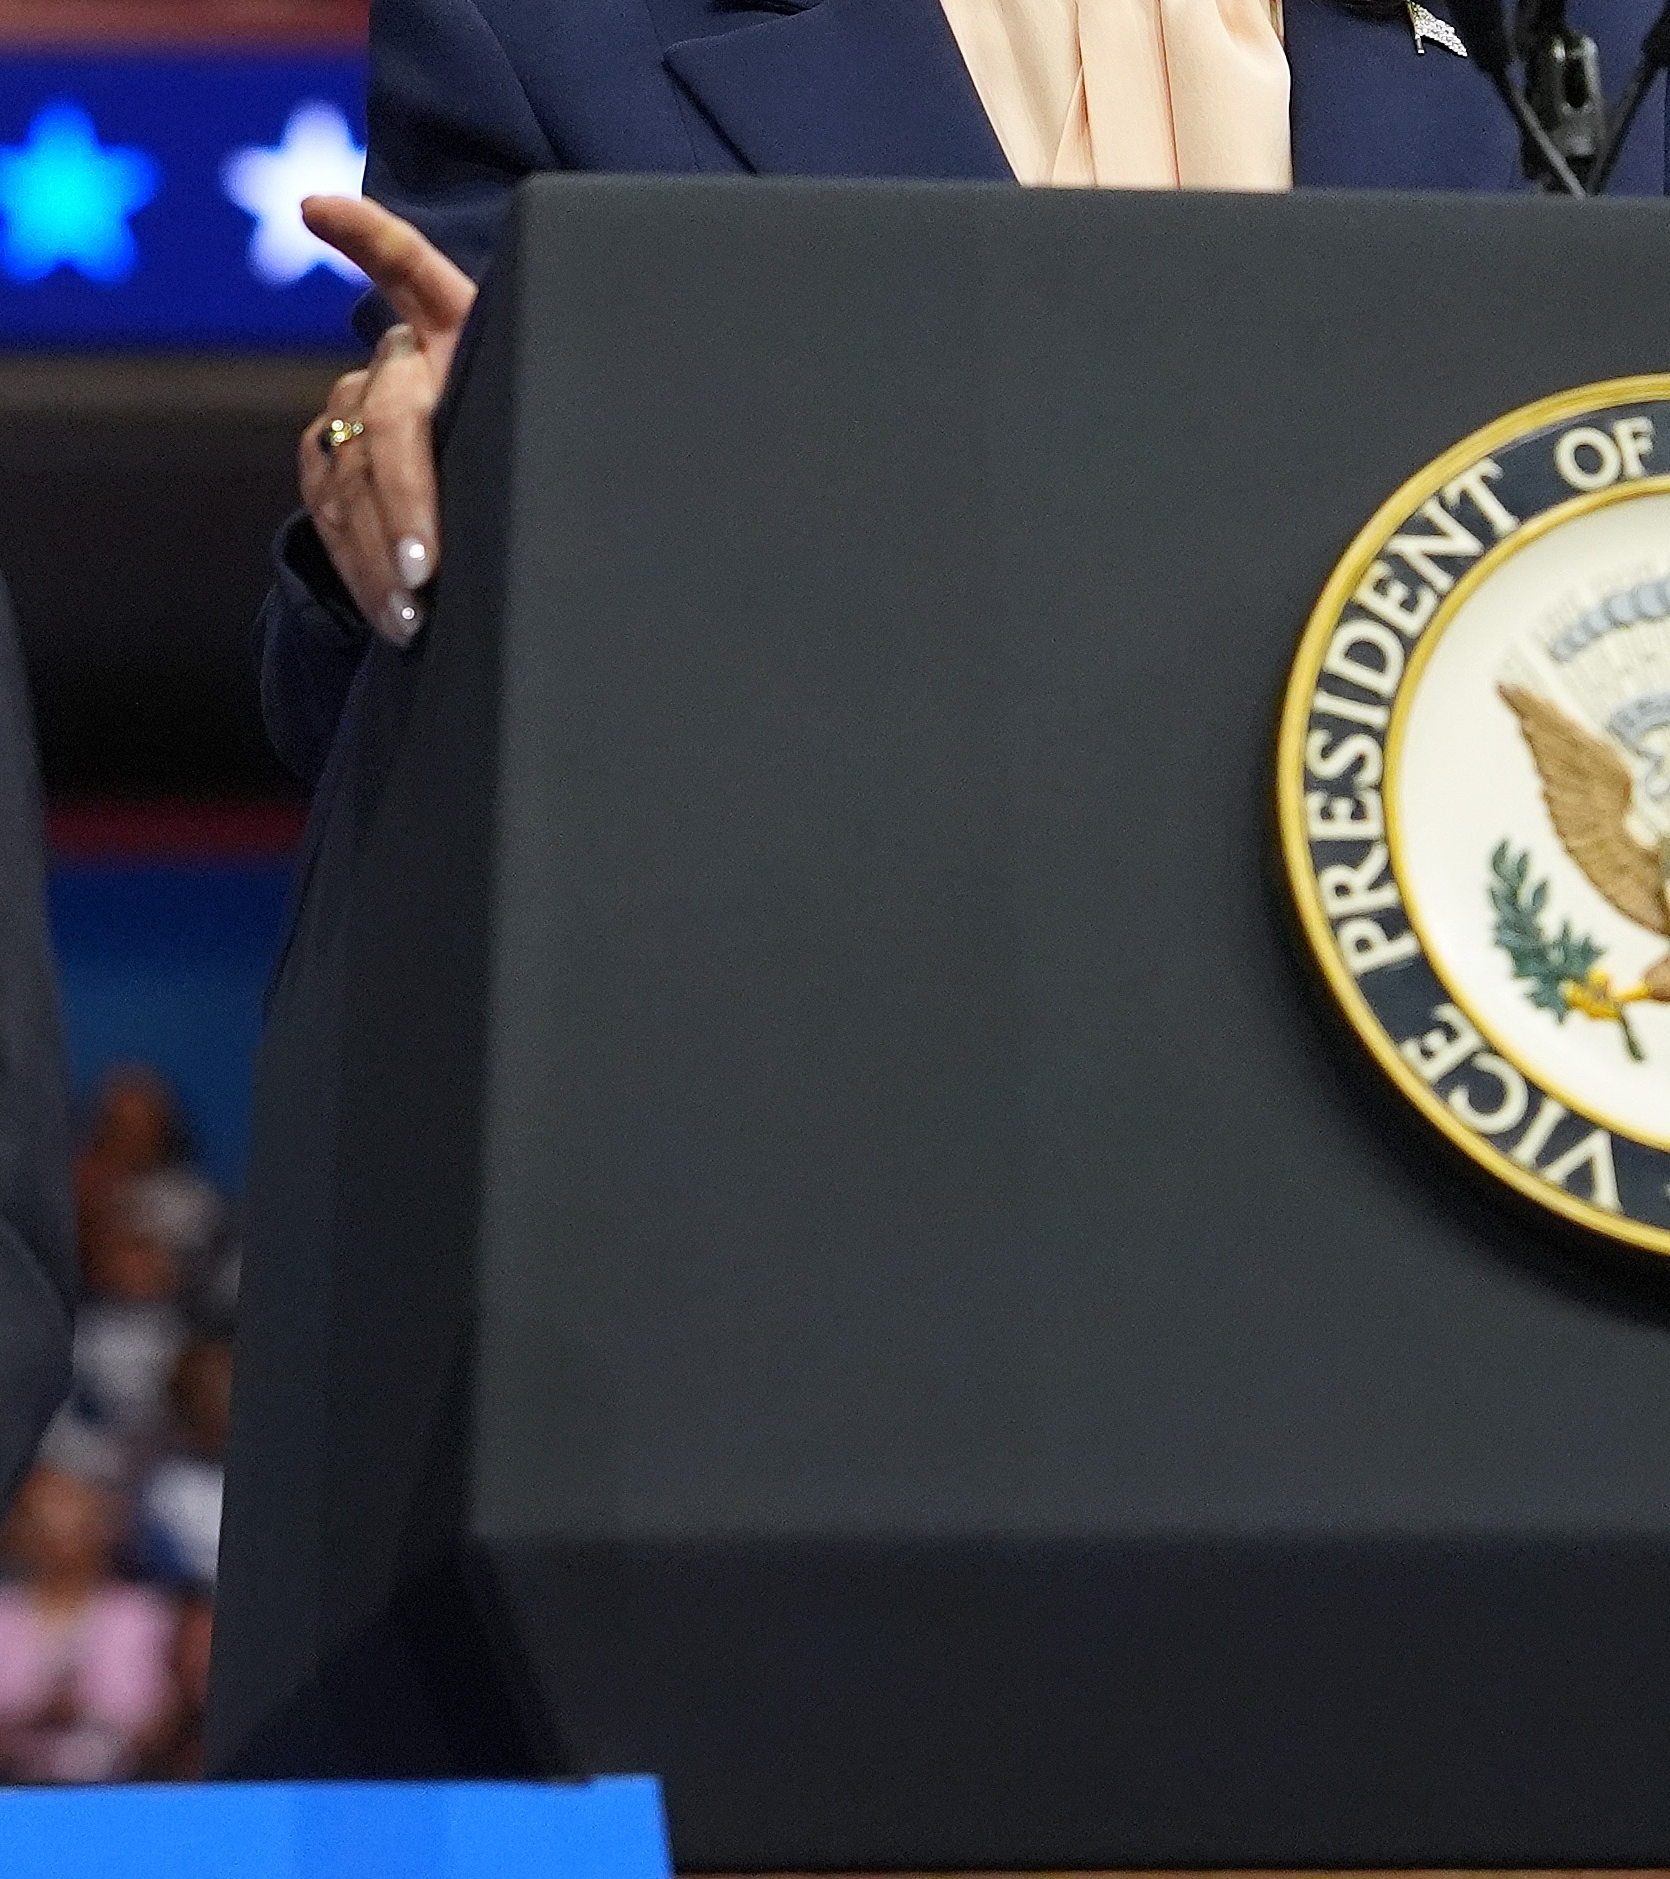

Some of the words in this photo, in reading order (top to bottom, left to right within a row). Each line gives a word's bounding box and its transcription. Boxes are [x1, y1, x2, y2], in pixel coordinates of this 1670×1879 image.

[1554, 417, 1655, 494] OF
[1305, 458, 1523, 977] PRESIDENT
[1400, 1004, 1624, 1213] VICE
